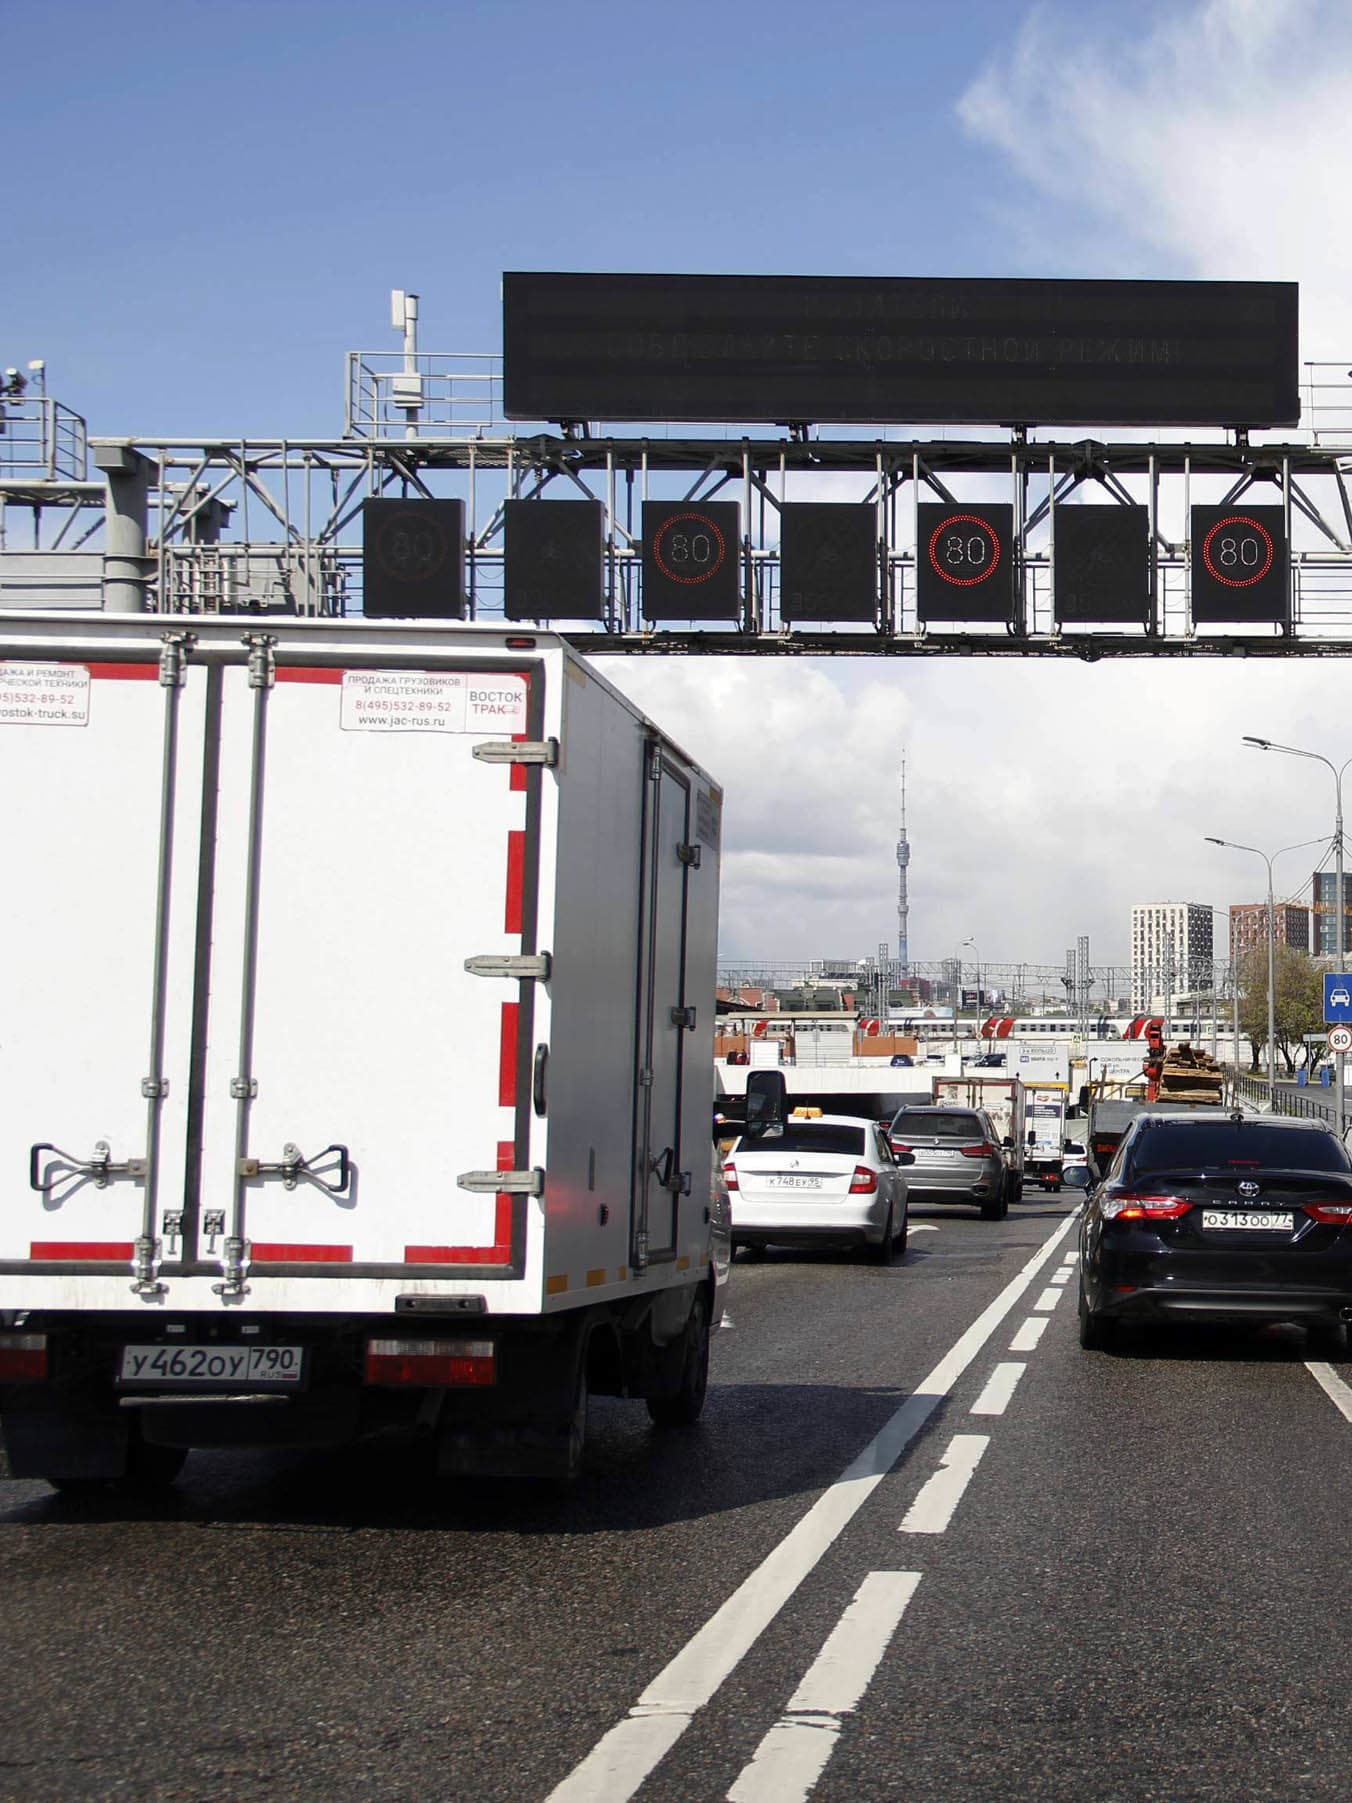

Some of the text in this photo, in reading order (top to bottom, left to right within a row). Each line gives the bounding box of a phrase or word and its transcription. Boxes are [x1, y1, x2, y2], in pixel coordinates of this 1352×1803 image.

[671, 534, 711, 563] 80
[946, 535, 986, 565] 80
[1220, 537, 1258, 566] 80
[36, 669, 75, 678] РЕМОНТ
[45, 680, 88, 689] ТЕХНИКИ
[349, 675, 461, 687] ПРОДАЖА ГРУЗОВИКОВ
[364, 686, 444, 696] И СПЕЦТЕХНИКИ
[469, 691, 522, 703] ВОСТОК
[0, 692, 75, 705] 5)532-89-52
[355, 700, 452, 712] 8(495)532-89-52
[472, 703, 506, 715] ТРАК
[358, 715, 446, 727] www.jac-rus.ru
[1333, 1034, 1348, 1045] 80
